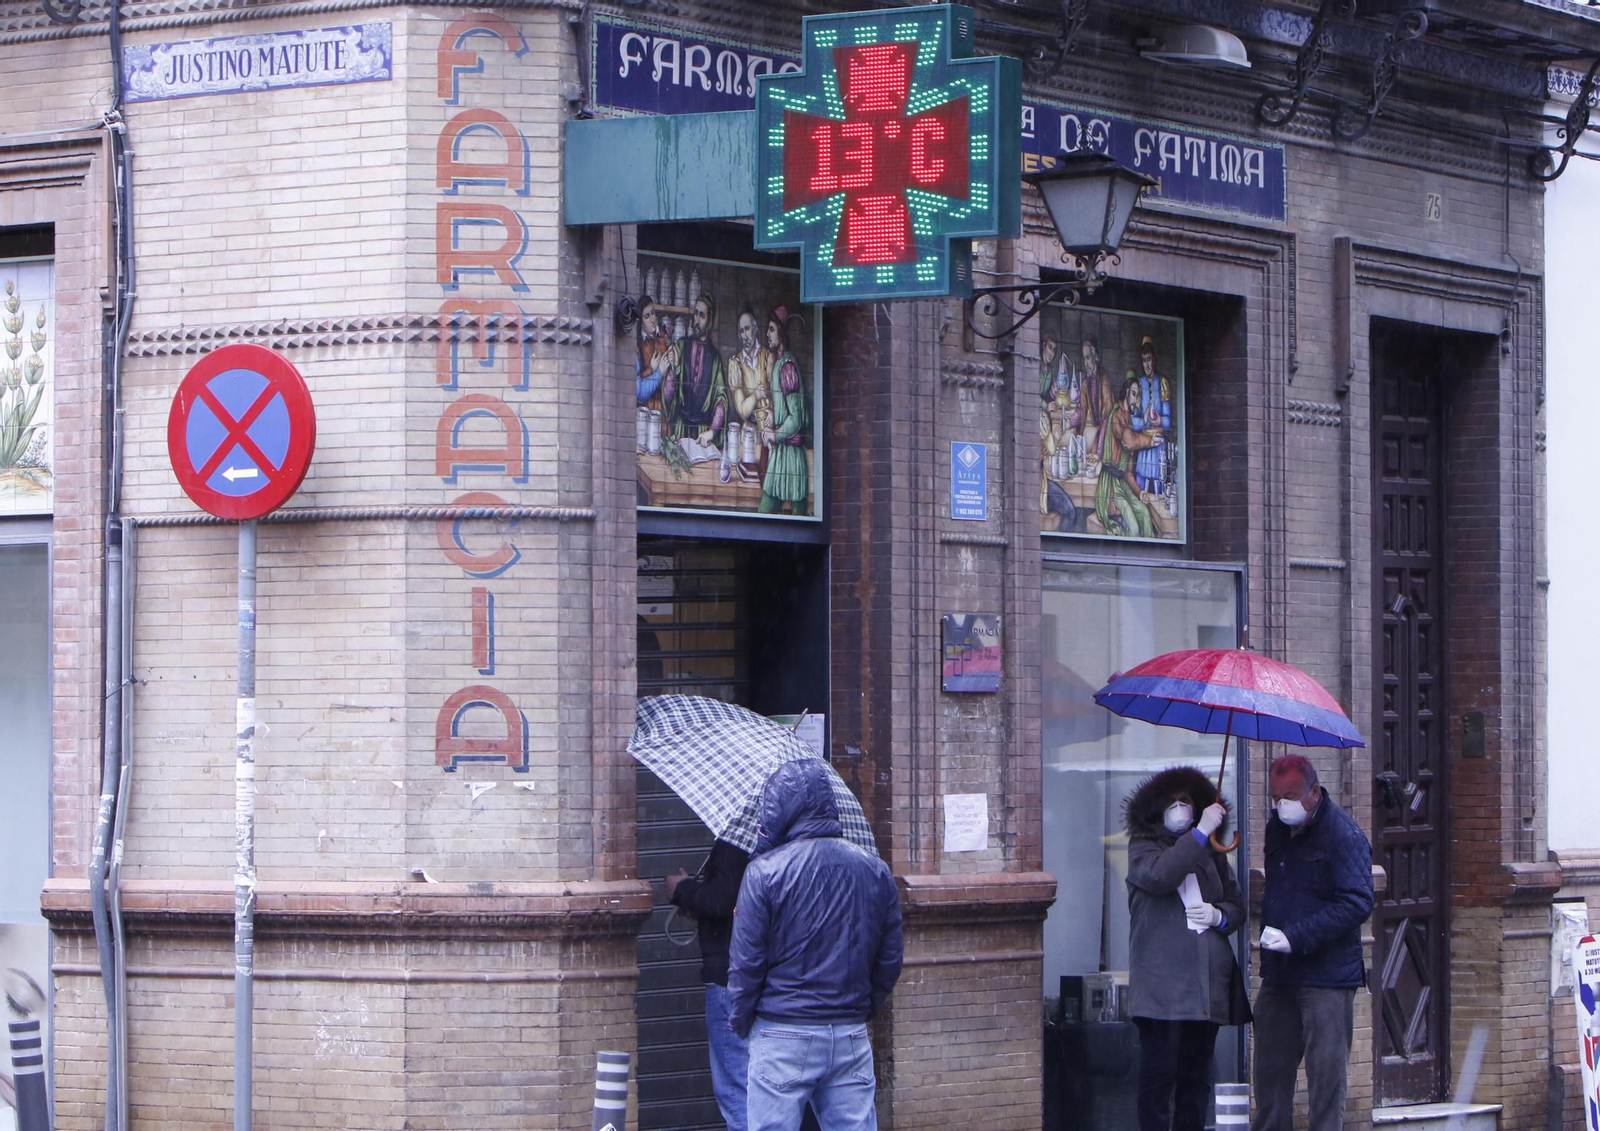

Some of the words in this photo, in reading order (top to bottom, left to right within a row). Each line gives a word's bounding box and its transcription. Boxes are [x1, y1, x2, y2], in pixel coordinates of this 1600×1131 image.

[165, 49, 253, 85] JUSTINO
[258, 40, 347, 77] MATUTE
[1060, 114, 1111, 155] DE
[1134, 128, 1265, 188] FATIMA
[1427, 194, 1441, 220] 75
[436, 12, 531, 773] FARMACIA
[957, 470, 981, 481] Artys
